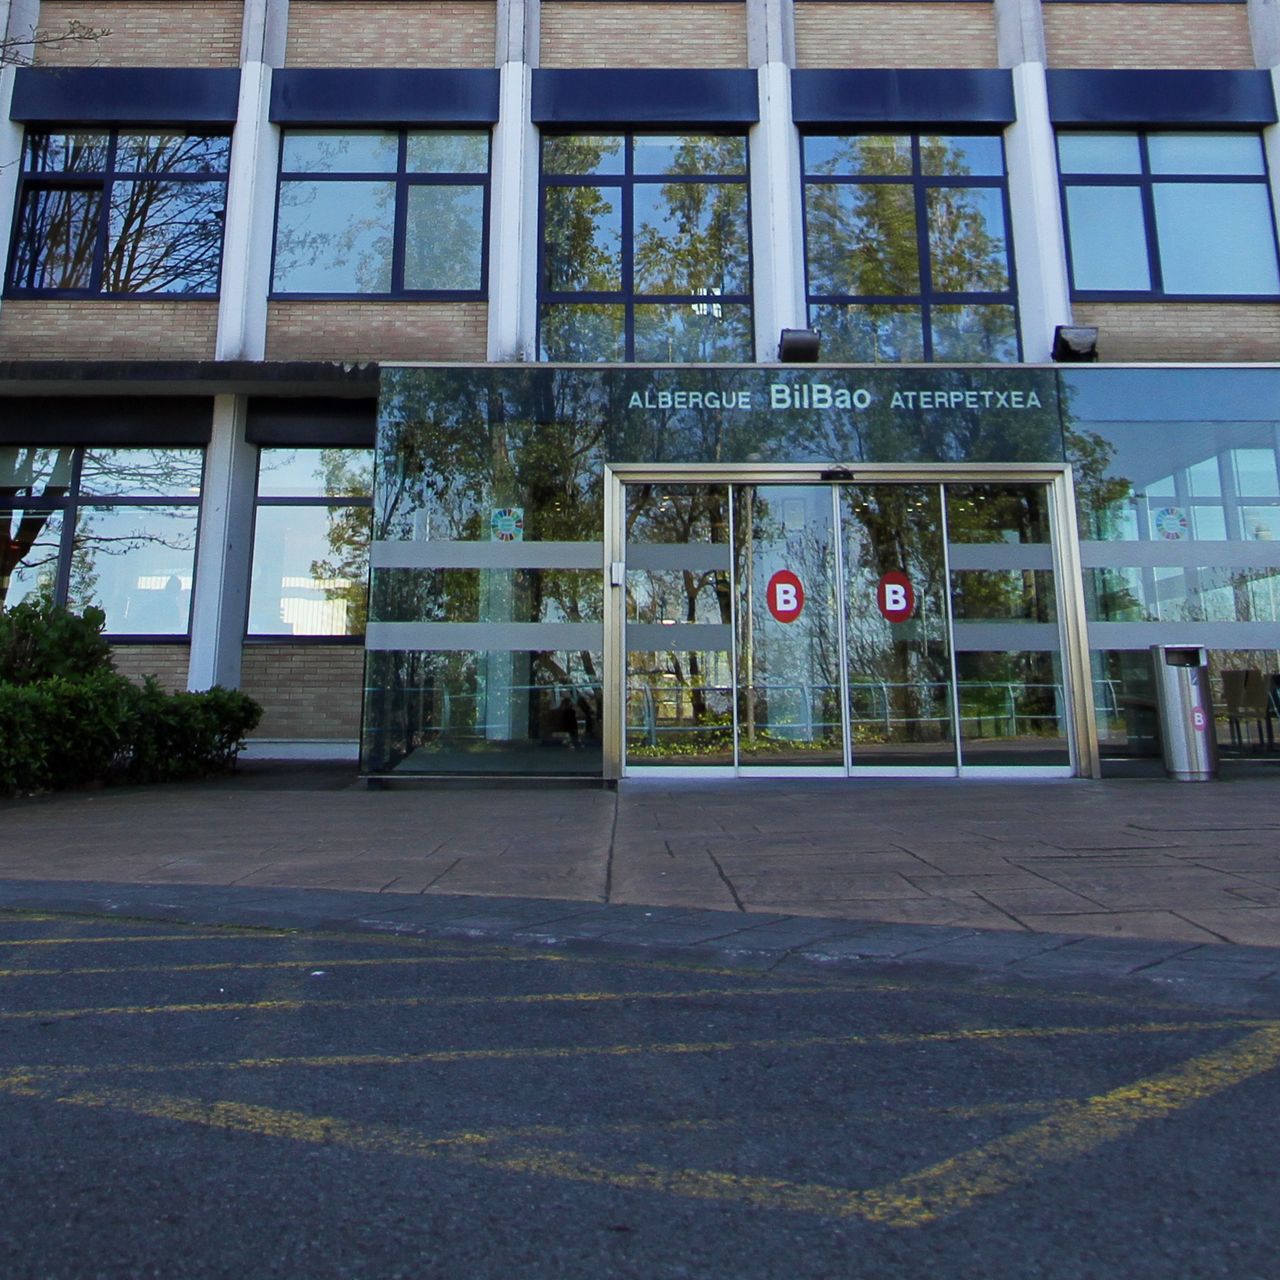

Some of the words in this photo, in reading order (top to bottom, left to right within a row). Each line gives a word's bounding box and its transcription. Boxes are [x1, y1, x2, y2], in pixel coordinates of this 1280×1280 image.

[628, 391, 751, 410] ALBERGUE
[770, 384, 871, 410] BilBao
[890, 391, 1042, 410] ATERPETXEA
[776, 583, 798, 611] B
[885, 583, 907, 611] B
